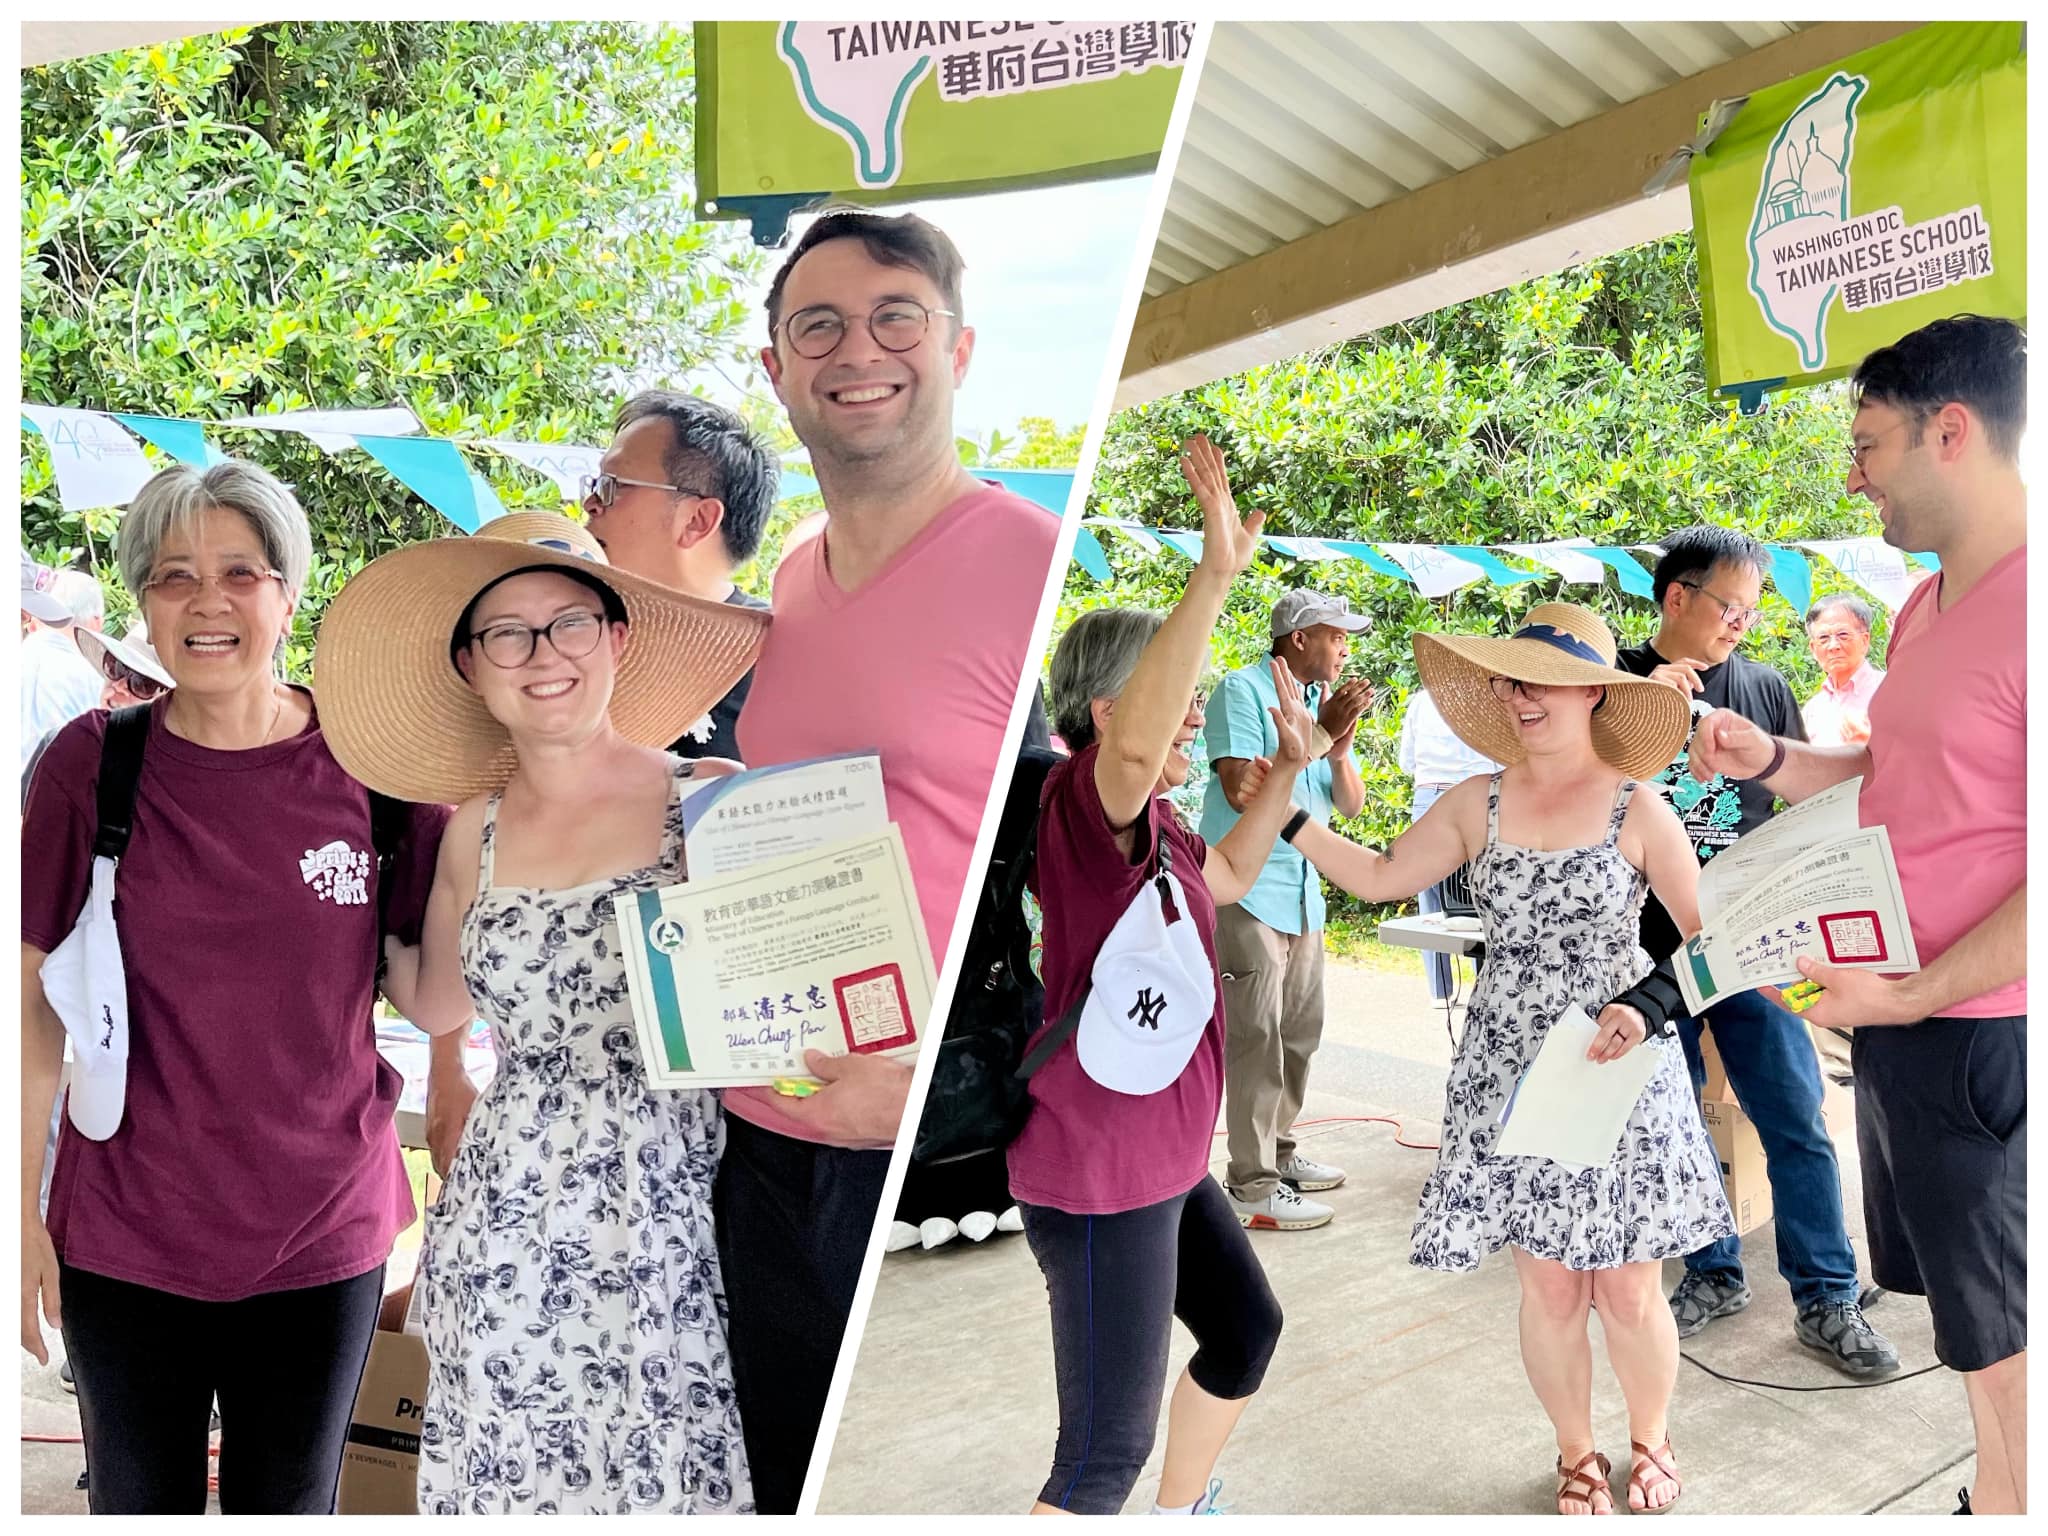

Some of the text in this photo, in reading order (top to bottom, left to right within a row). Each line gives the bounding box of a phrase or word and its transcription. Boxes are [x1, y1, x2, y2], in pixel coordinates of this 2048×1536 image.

[827, 21, 1034, 62] TAIWANE
[942, 21, 1195, 95] 華府台灣學校
[1773, 212, 1900, 265] WASHINGTON DC
[1777, 212, 1986, 293] TAIWANESE SCHOOL
[1844, 243, 1991, 308] 華府台灣學校
[1127, 986, 1168, 1031] NY
